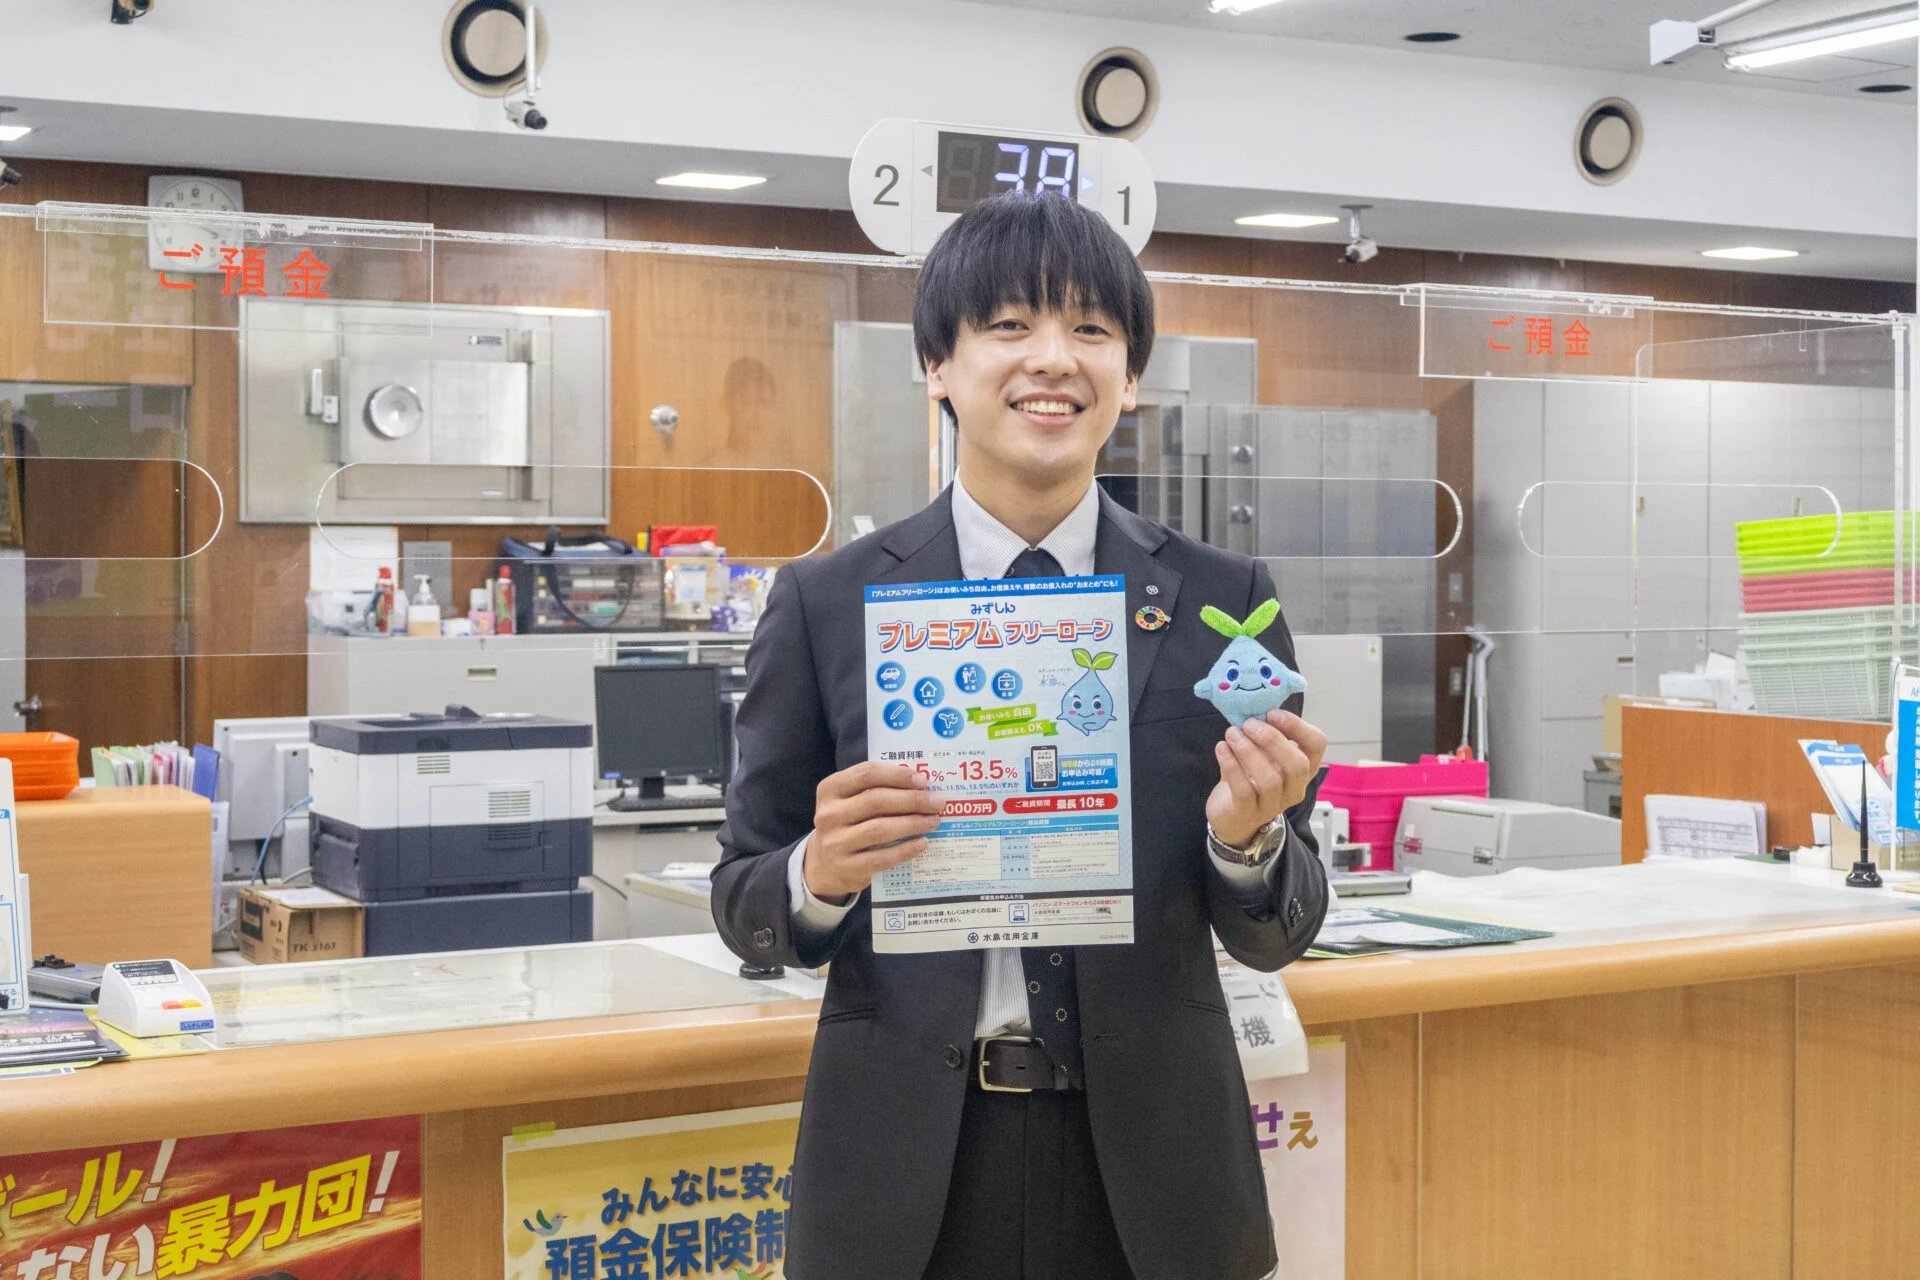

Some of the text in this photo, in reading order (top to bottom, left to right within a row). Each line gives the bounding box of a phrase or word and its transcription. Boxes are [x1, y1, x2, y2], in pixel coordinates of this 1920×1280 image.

[873, 164, 900, 206] 2
[1117, 186, 1130, 225] 1
[160, 243, 331, 298] ご預金
[1489, 315, 1591, 356] ご預金
[971, 602, 1016, 615] みずしん
[880, 750, 924, 761] ご融資利率
[983, 932, 1039, 942] 水島信用金庫
[1226, 980, 1280, 1011] ード
[1233, 1015, 1276, 1049] 機
